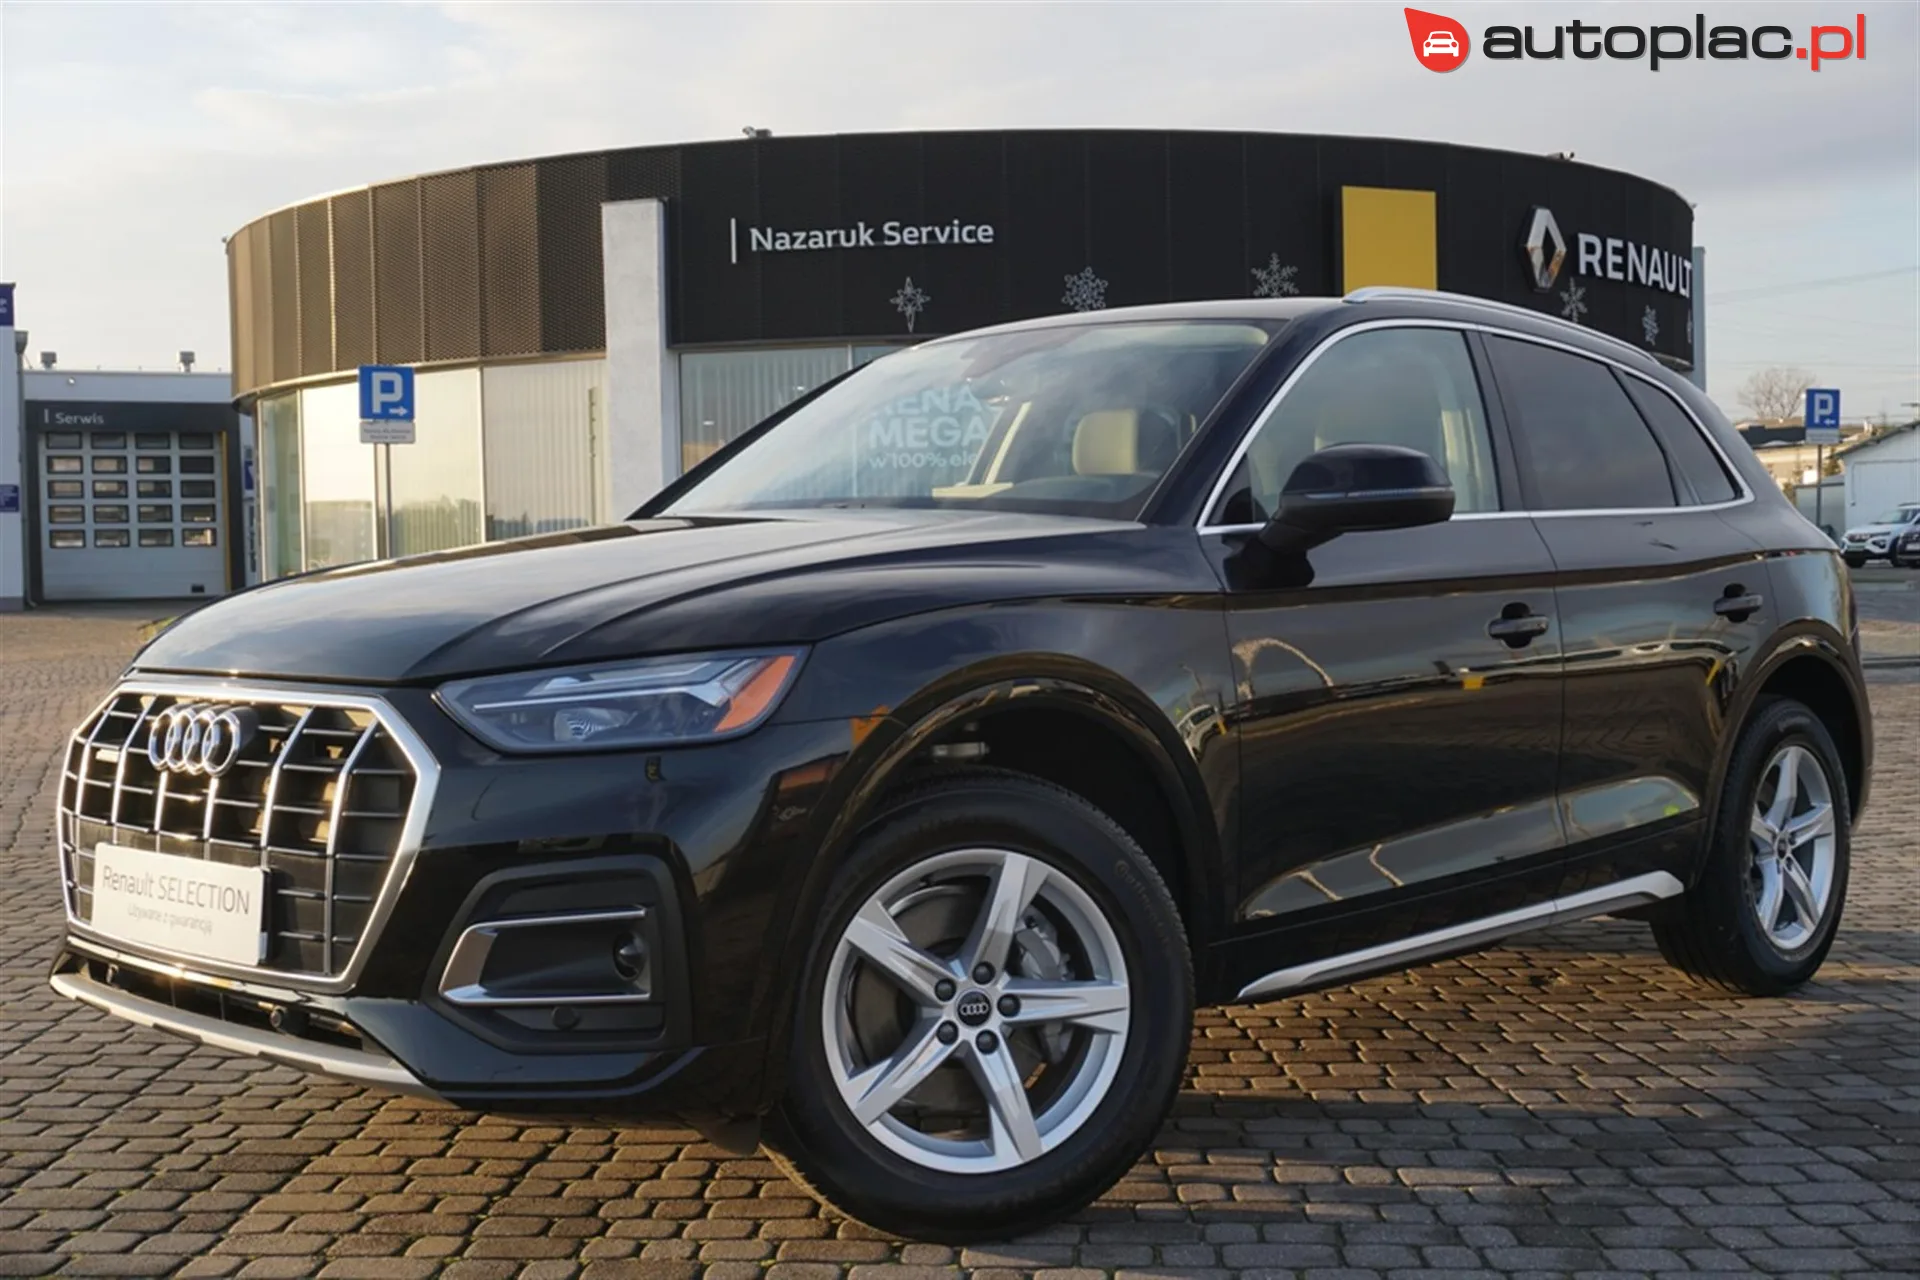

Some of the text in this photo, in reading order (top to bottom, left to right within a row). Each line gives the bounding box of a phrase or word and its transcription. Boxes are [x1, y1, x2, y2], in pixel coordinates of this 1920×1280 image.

[749, 219, 994, 252] Nazaruk Service
[1577, 232, 1693, 299] RENAULT
[372, 371, 403, 414] P
[1814, 392, 1833, 423] P
[55, 411, 105, 425] Serwis
[102, 865, 250, 915] Renault SELECTION
